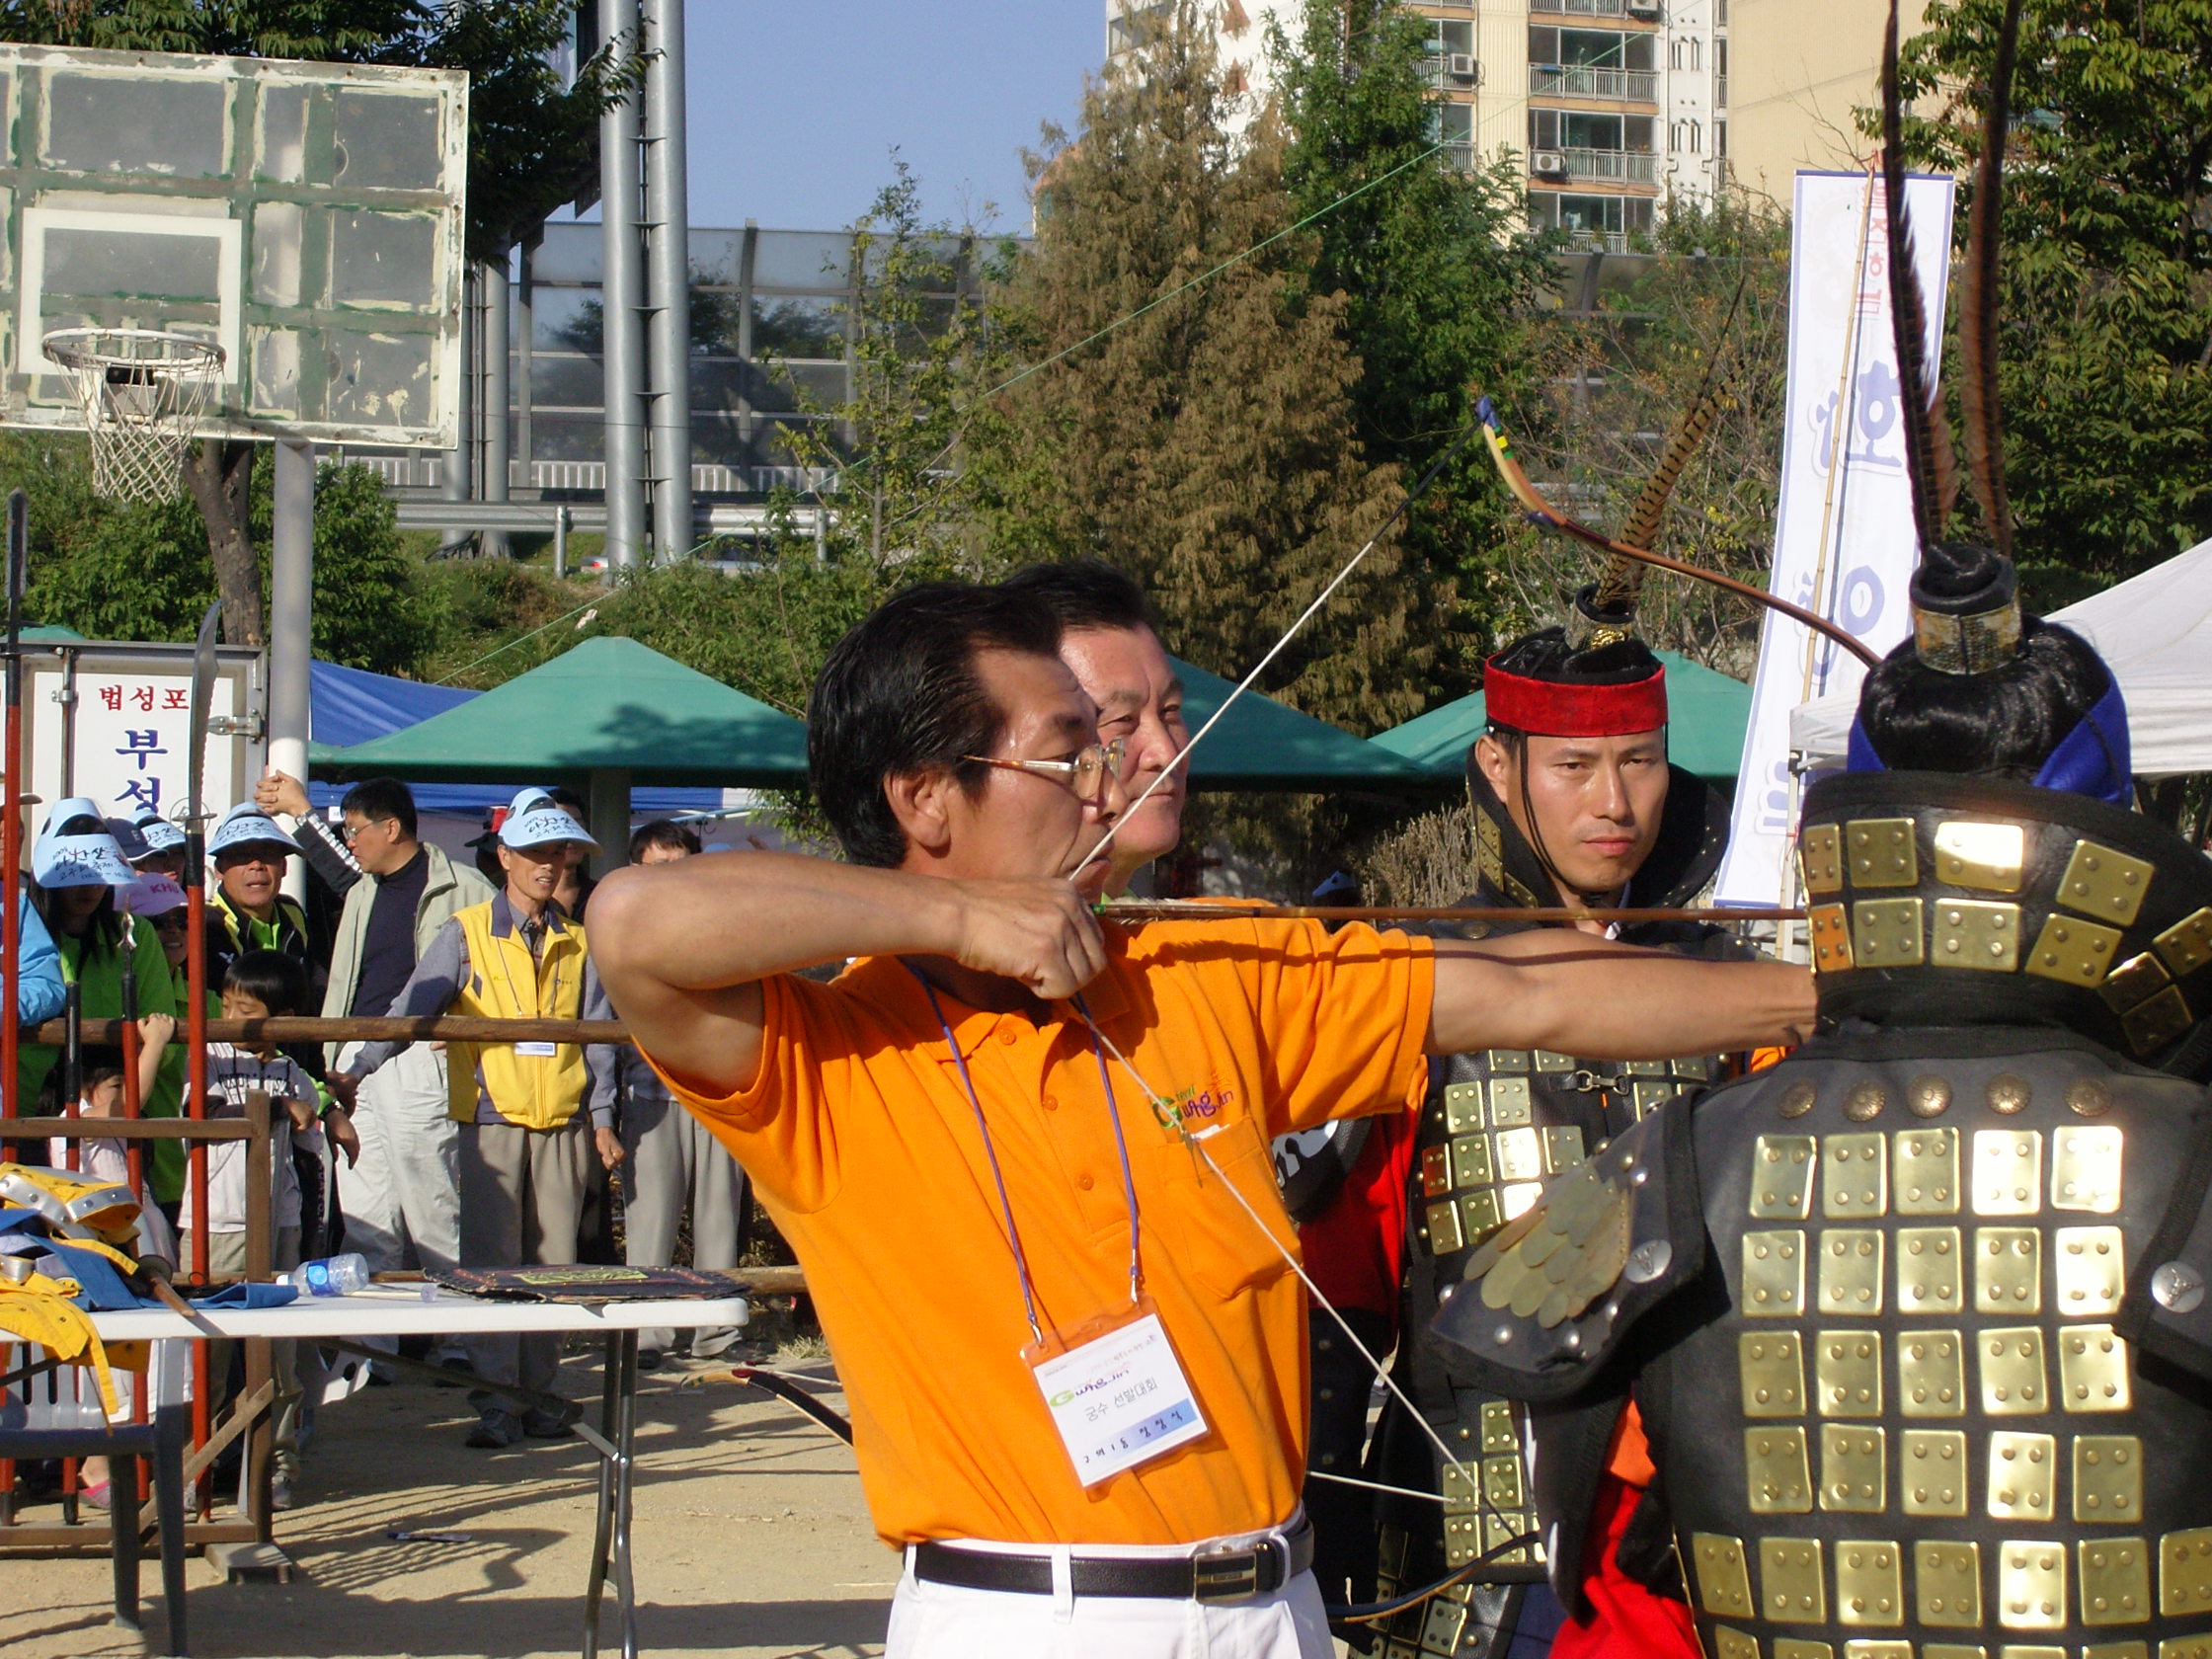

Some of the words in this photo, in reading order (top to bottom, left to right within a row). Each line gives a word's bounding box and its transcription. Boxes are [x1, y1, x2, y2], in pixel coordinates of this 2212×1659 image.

[100, 684, 190, 711] 법성포
[1084, 1402, 1110, 1422] 궁수
[1113, 1377, 1158, 1409] 선발대회
